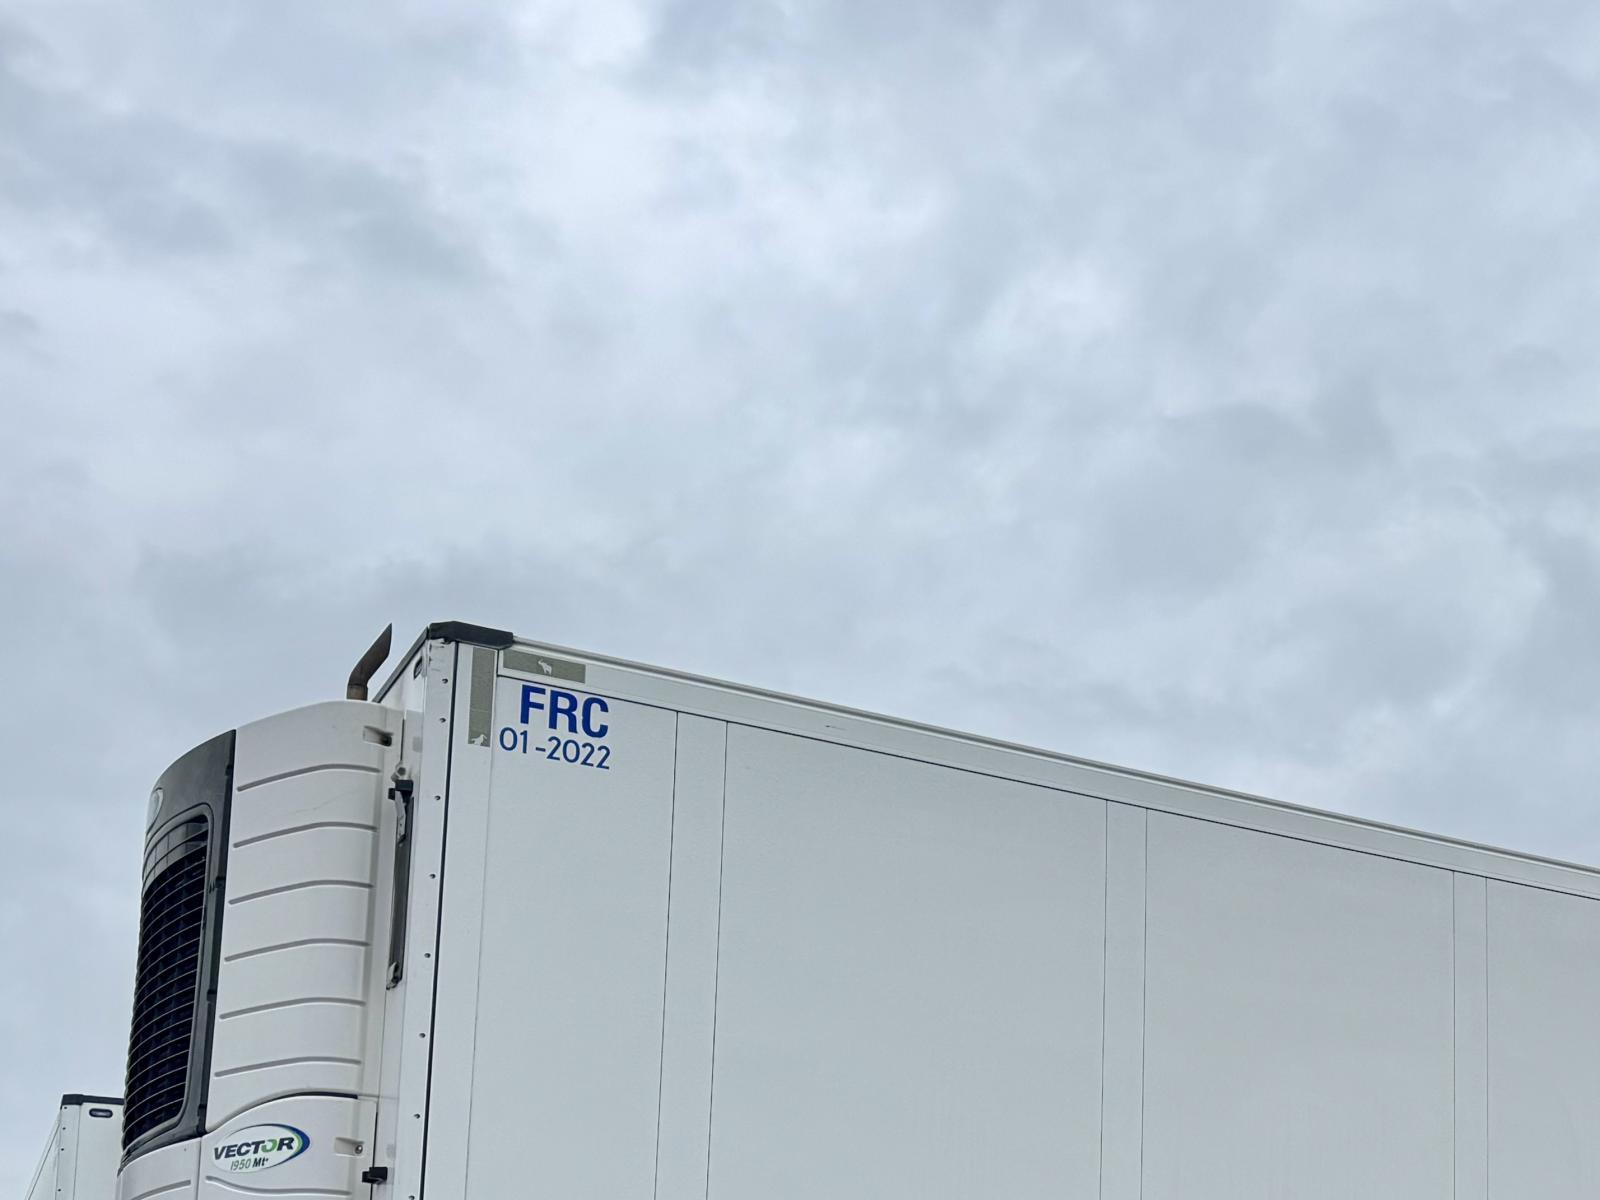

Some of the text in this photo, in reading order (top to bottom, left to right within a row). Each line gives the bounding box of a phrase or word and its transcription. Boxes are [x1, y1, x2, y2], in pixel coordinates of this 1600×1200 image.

[520, 684, 609, 739] FRC
[499, 727, 611, 770] 01-2022
[213, 1137, 295, 1160] VECTOR
[230, 1158, 251, 1171] 1950
